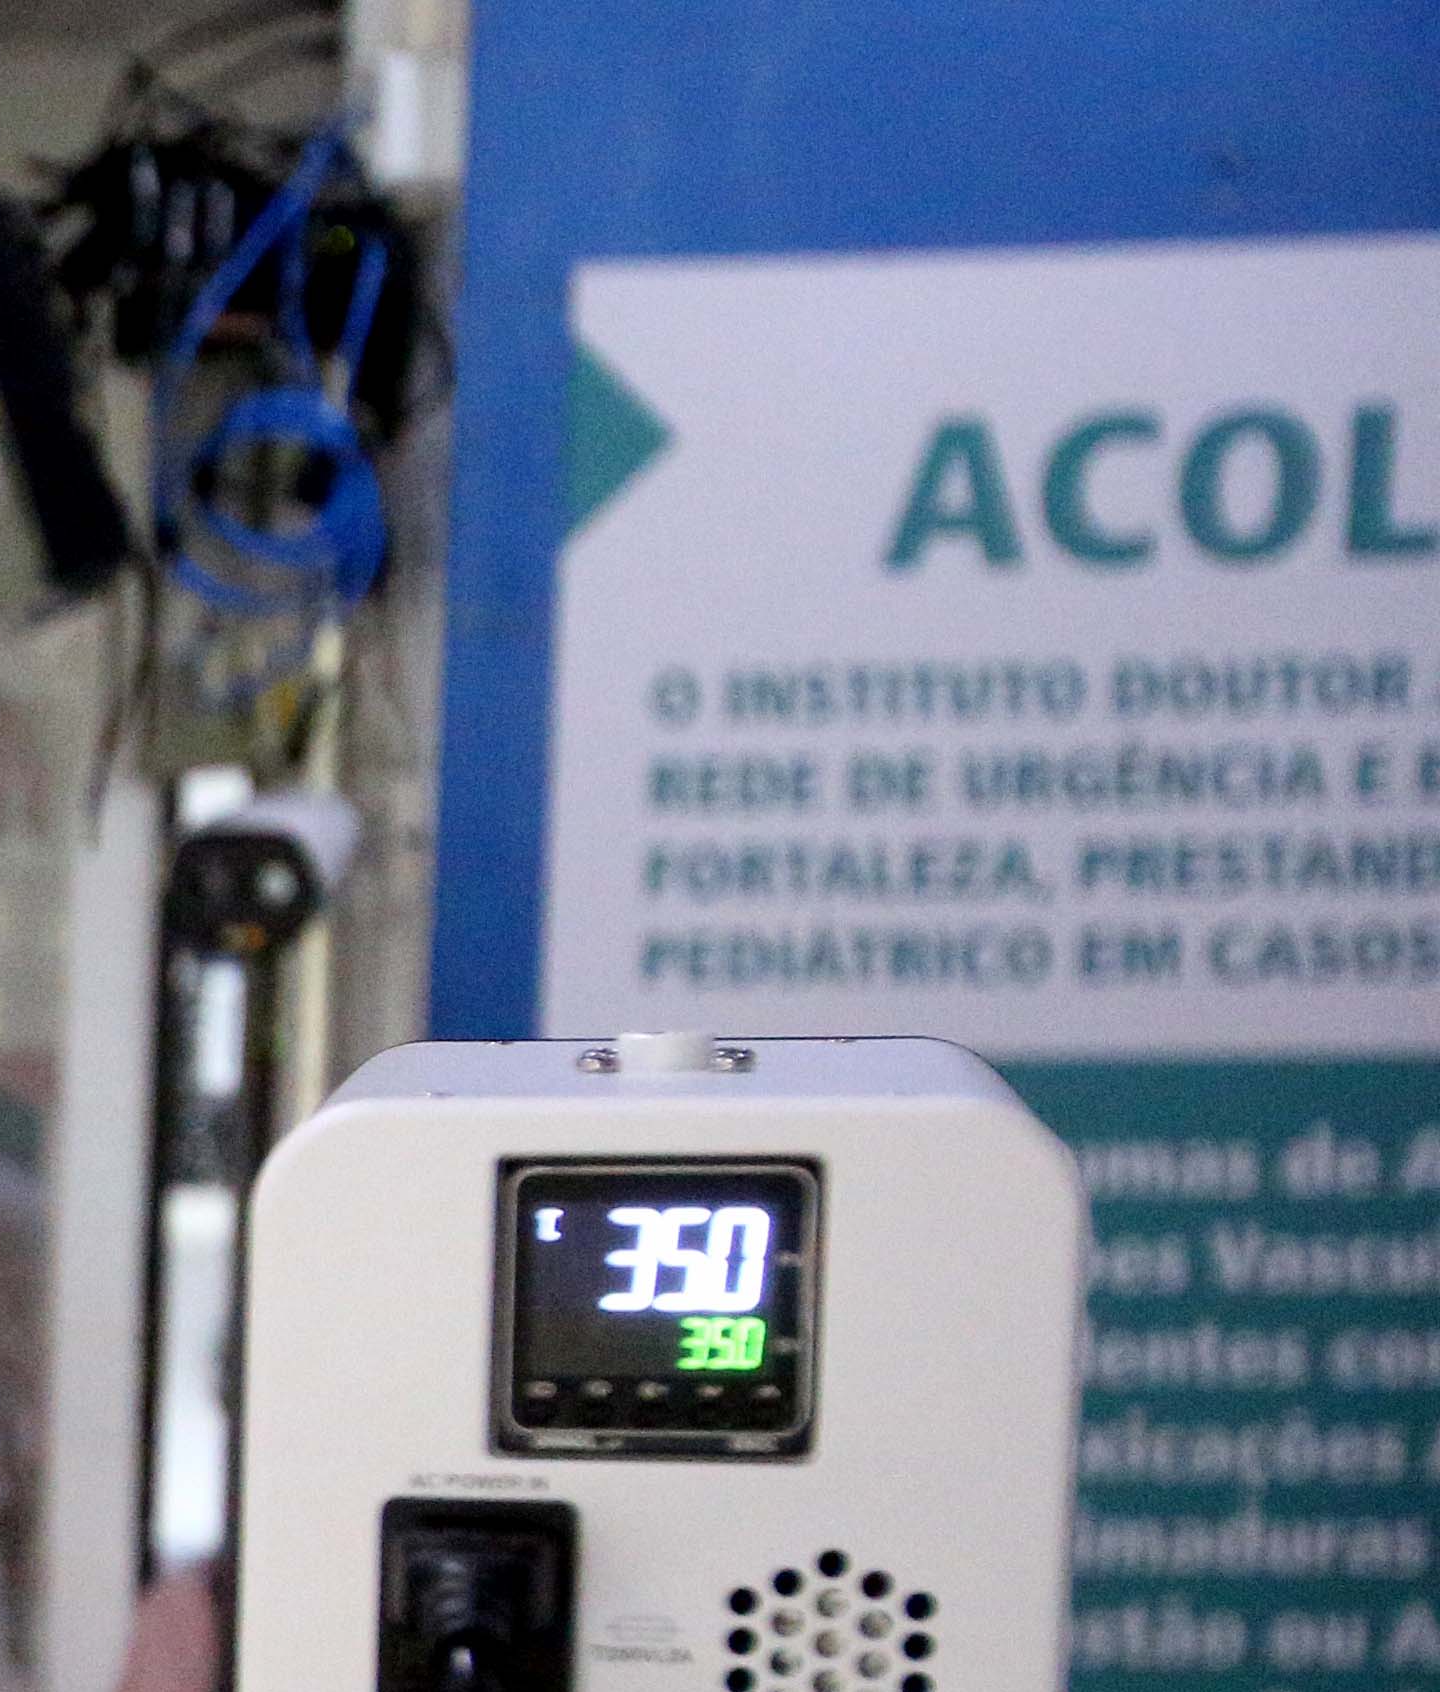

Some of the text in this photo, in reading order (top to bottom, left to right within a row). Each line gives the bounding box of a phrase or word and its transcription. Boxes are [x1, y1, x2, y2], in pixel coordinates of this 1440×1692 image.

[885, 402, 1440, 570] ACOL
[649, 650, 1410, 728] O INSTITUTO DOUTOR
[647, 754, 819, 811] REDE
[846, 750, 930, 808] DE
[961, 735, 1326, 804] URGÊNCIA
[1354, 746, 1391, 797] E
[643, 836, 1053, 902] FORTALEZA,
[1076, 926, 1180, 983] EM
[1209, 922, 1440, 983] CASOS
[1282, 1120, 1380, 1195] de
[1269, 1611, 1369, 1672] ou
